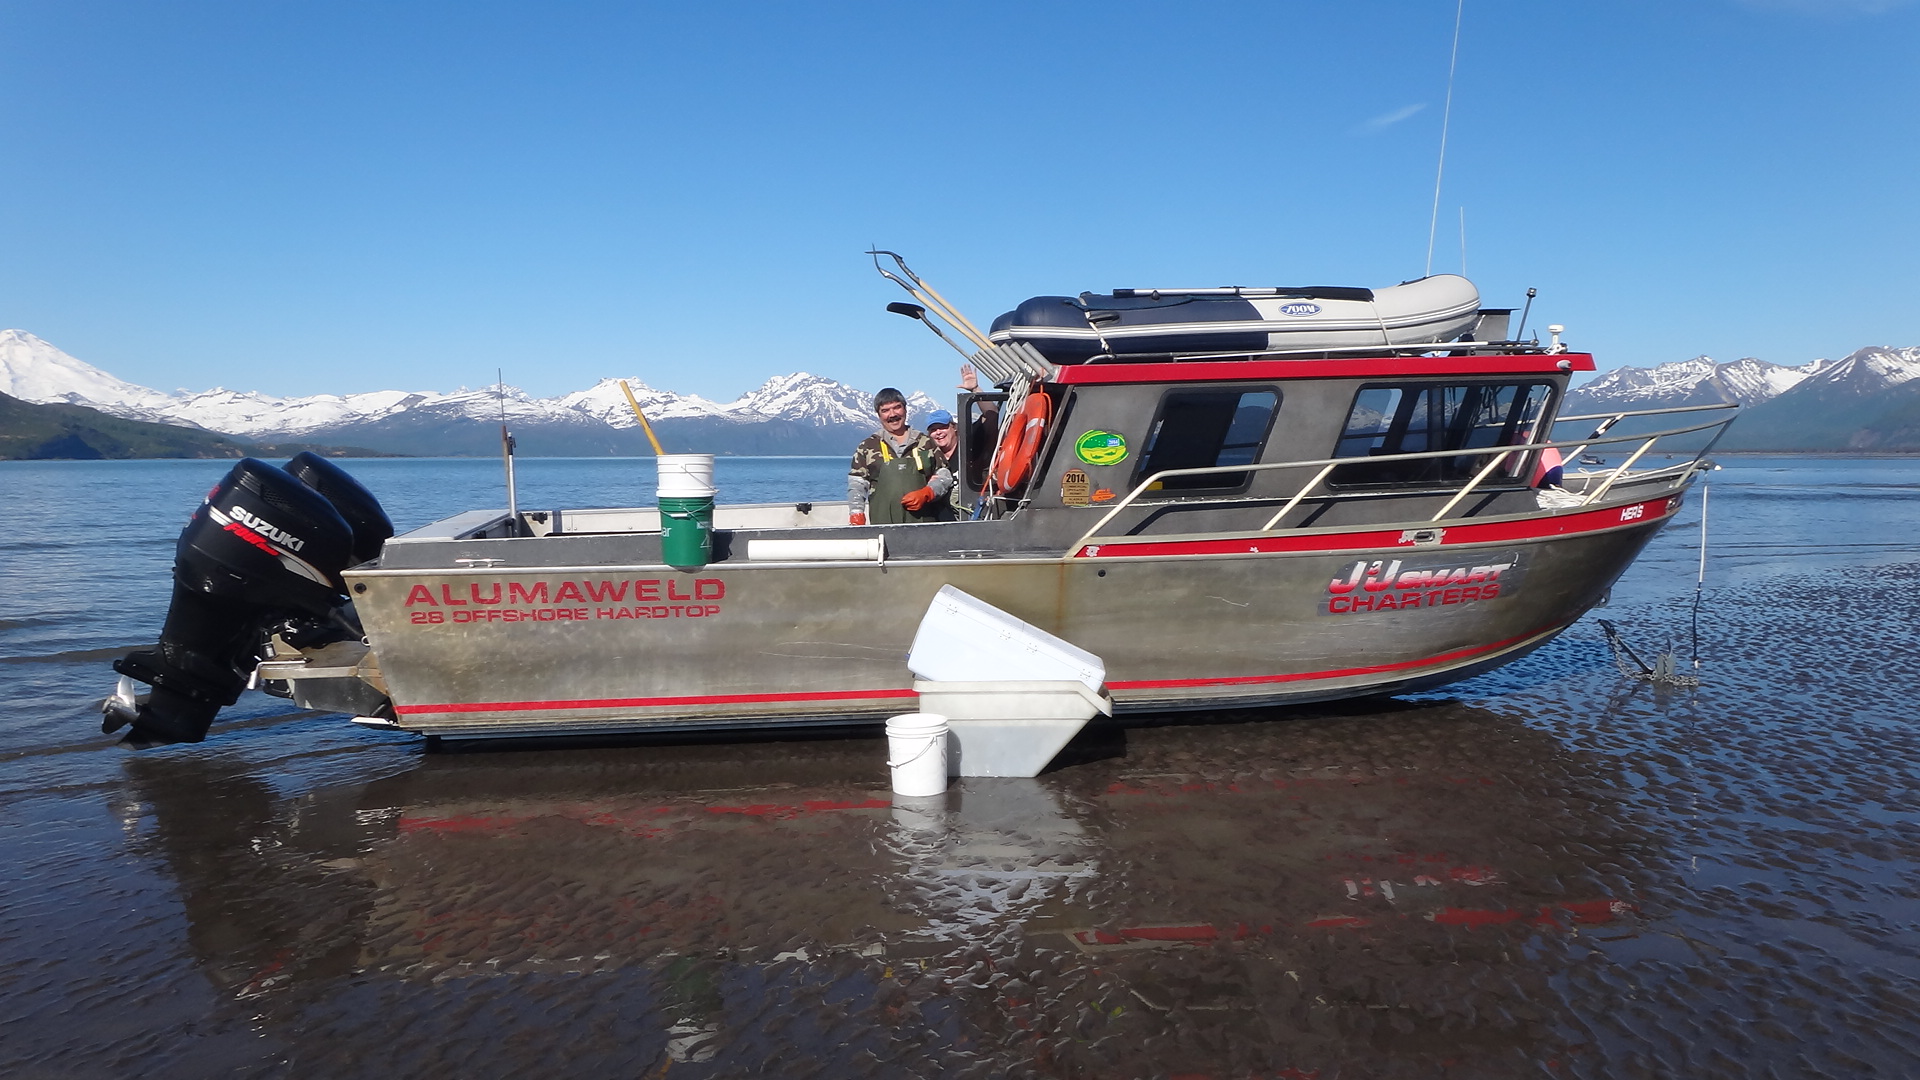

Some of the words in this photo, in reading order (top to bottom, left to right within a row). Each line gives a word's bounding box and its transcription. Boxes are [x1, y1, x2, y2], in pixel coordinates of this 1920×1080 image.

[1066, 473, 1085, 483] 2014
[229, 505, 304, 552] SUZUKI
[403, 577, 726, 607] ALUMAWELD
[1328, 583, 1502, 613] CHARTERS
[410, 610, 444, 625] 28
[452, 608, 590, 624] OFFSHORE
[596, 604, 722, 621] HARDTOP
